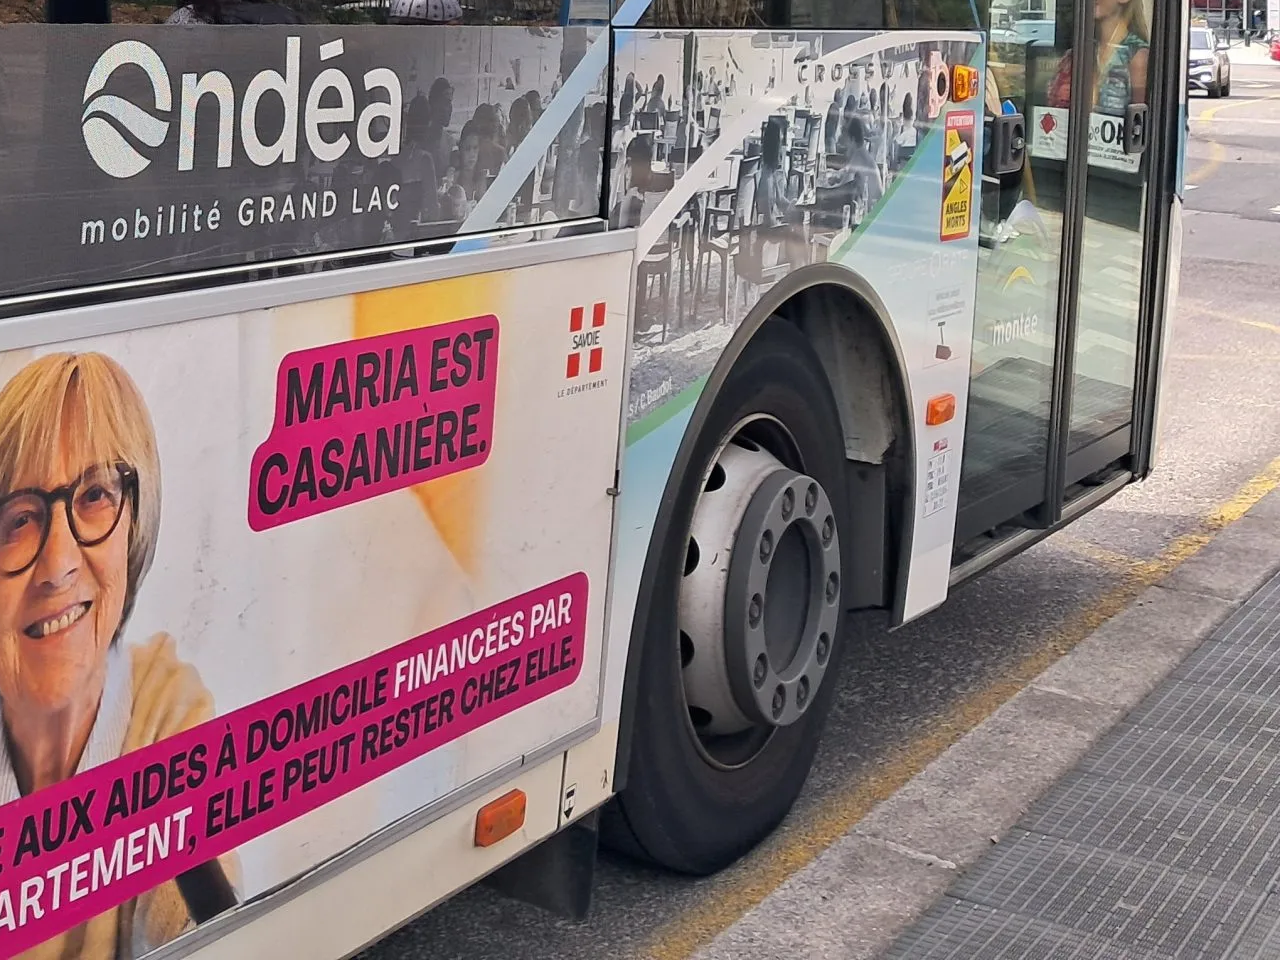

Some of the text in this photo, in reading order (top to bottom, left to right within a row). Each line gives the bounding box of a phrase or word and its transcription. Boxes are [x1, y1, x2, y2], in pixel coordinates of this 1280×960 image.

[81, 184, 400, 245] mobilité GRAND LAC
[945, 200, 968, 214] ANGLES
[945, 214, 966, 229] MORTS
[572, 330, 600, 350] SAVOIE
[993, 307, 1038, 346] montée
[285, 328, 494, 426] MARIA EST
[557, 388, 565, 398] LE
[257, 403, 486, 515] CASANIÈRE.
[13, 790, 97, 866] AUX
[103, 743, 208, 827] AIDES
[215, 723, 238, 778] À
[246, 668, 389, 765] DOMICILE
[393, 610, 525, 699] FINANCÉES
[529, 592, 572, 639] PAR
[205, 768, 276, 838] ELLE
[282, 733, 356, 802] PEUT
[360, 688, 456, 765] RESTER
[461, 656, 522, 715] CHEZ
[524, 635, 576, 687] ELLE.
